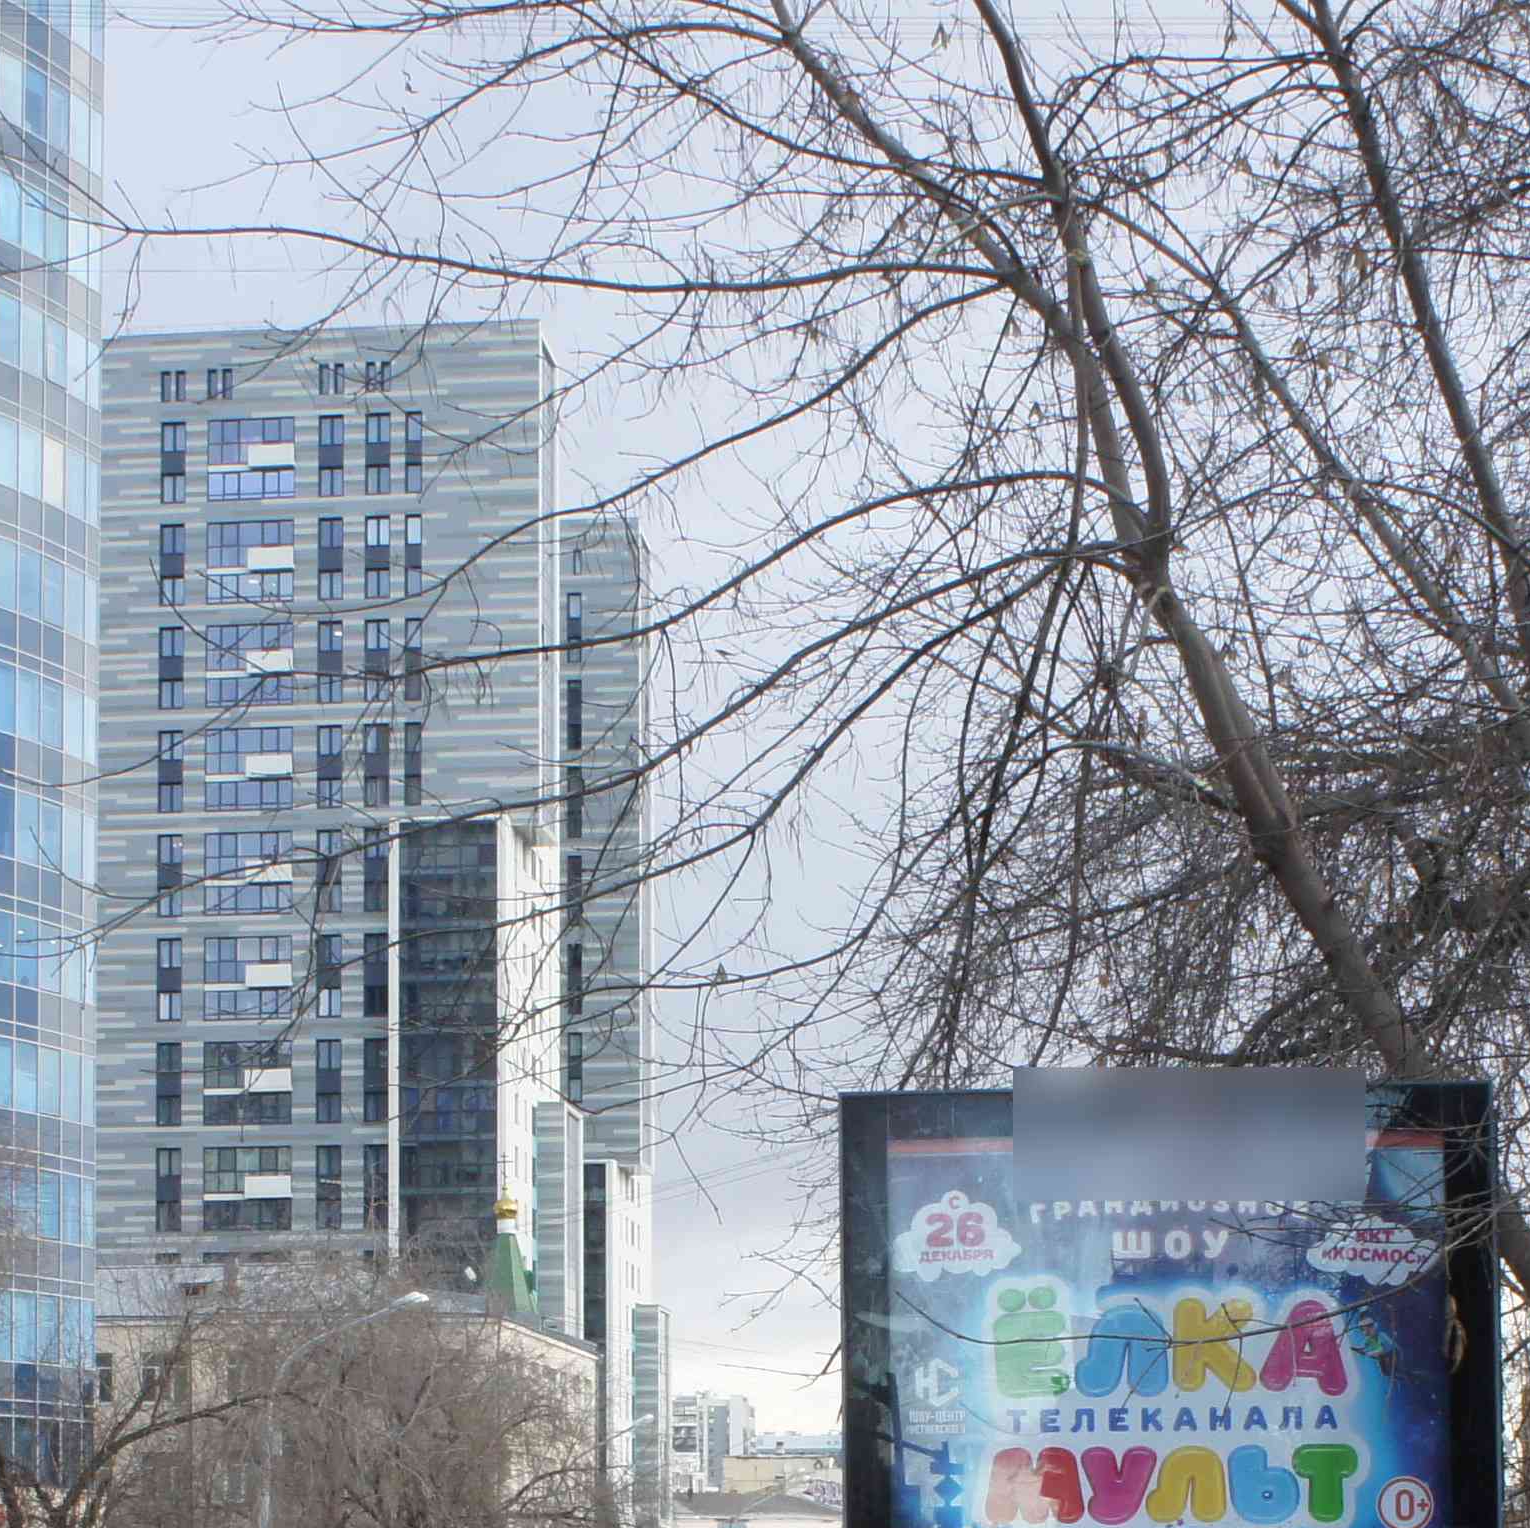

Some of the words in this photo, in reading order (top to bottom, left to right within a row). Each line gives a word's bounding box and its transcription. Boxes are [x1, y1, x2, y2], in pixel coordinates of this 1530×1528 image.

[925, 1212, 986, 1248] 26
[1112, 1230, 1229, 1259] ШОУ
[919, 1249, 996, 1264] ДЕКАБРЯ
[992, 1286, 1349, 1398] ЁЛКА
[1007, 1404, 1340, 1433] ТЕЛЕКАНАЛА
[985, 1442, 1359, 1526] МУЛЬТ
[1395, 1489, 1429, 1521] 0+
